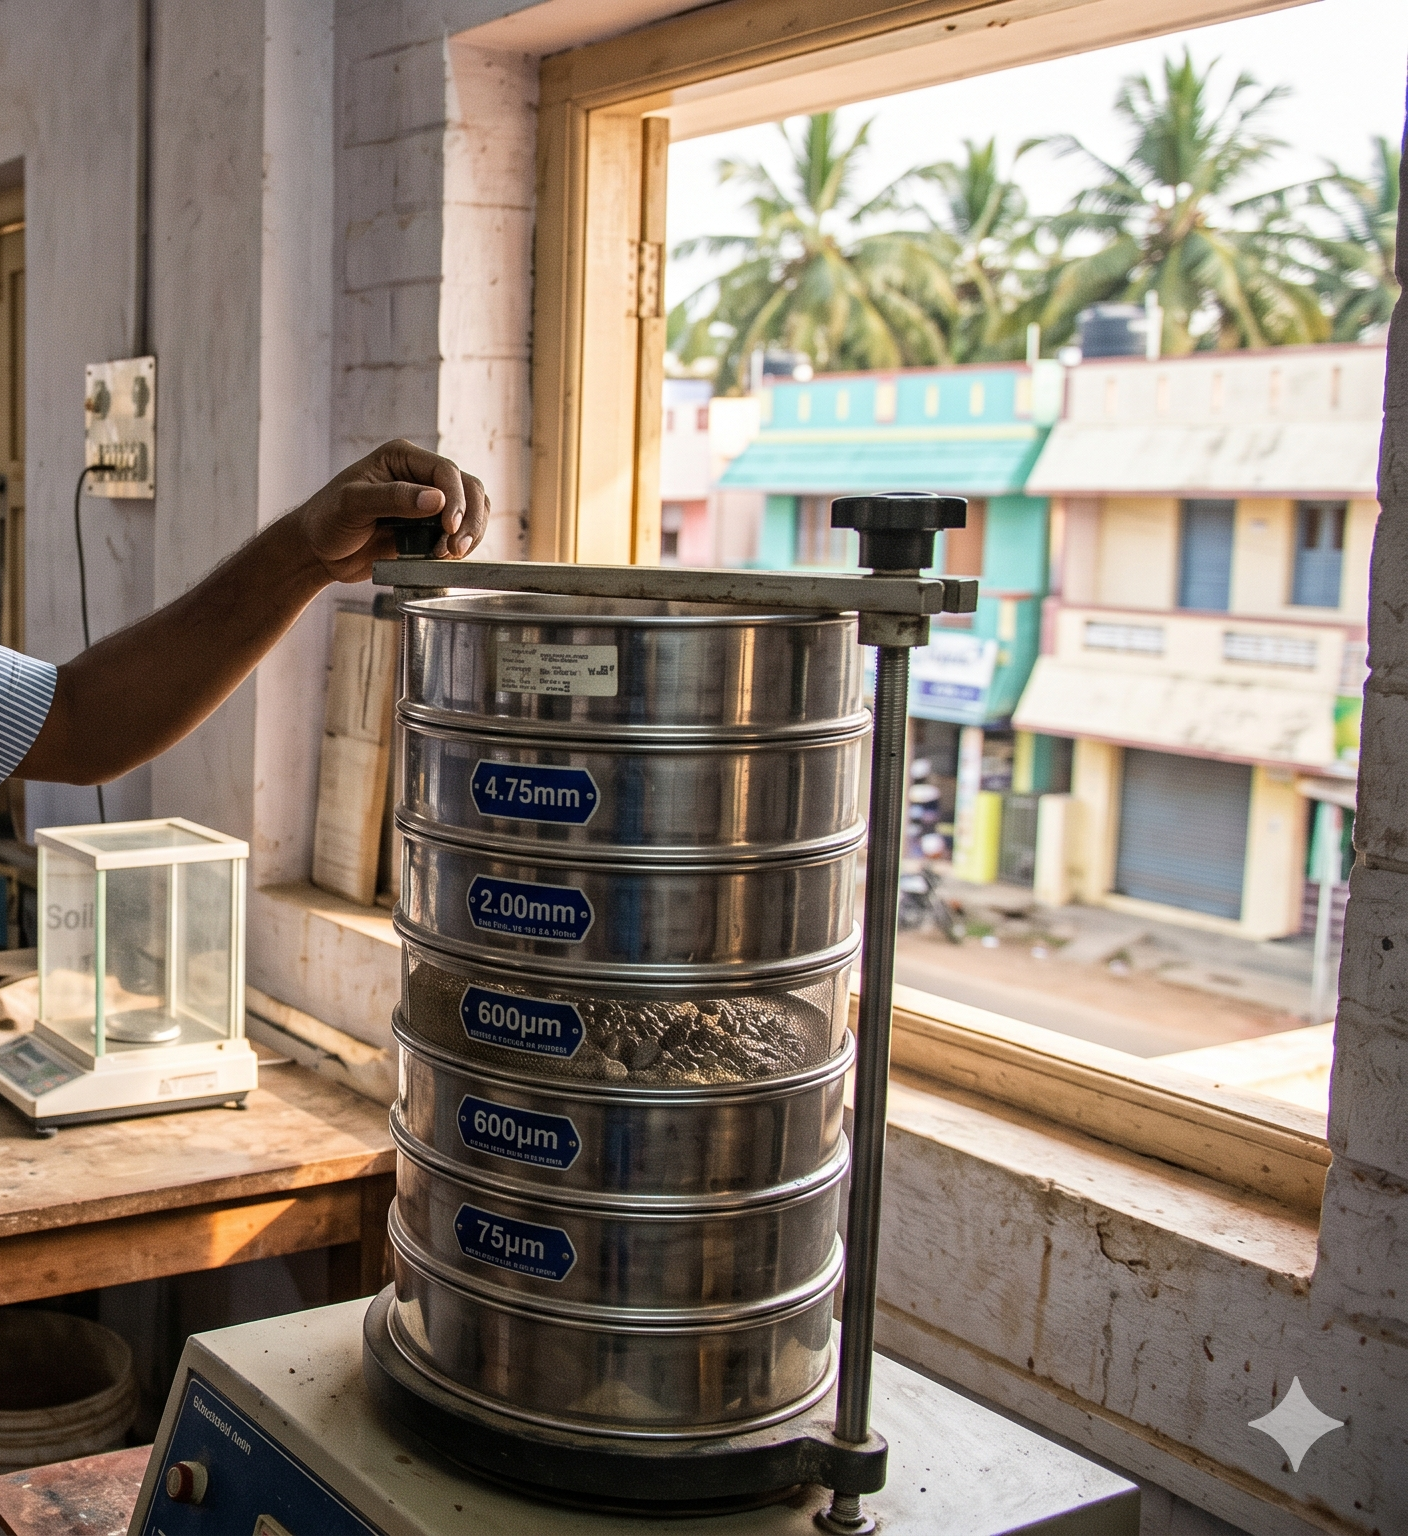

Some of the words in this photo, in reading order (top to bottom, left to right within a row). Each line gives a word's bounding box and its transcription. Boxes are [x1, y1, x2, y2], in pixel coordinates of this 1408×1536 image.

[484, 776, 580, 808] 4.75mm
[46, 902, 94, 930] Soil
[480, 889, 575, 924] 2.00mm
[478, 1001, 562, 1038] 600µm
[474, 1110, 558, 1149] 600µm
[477, 1219, 544, 1260] 75µm
